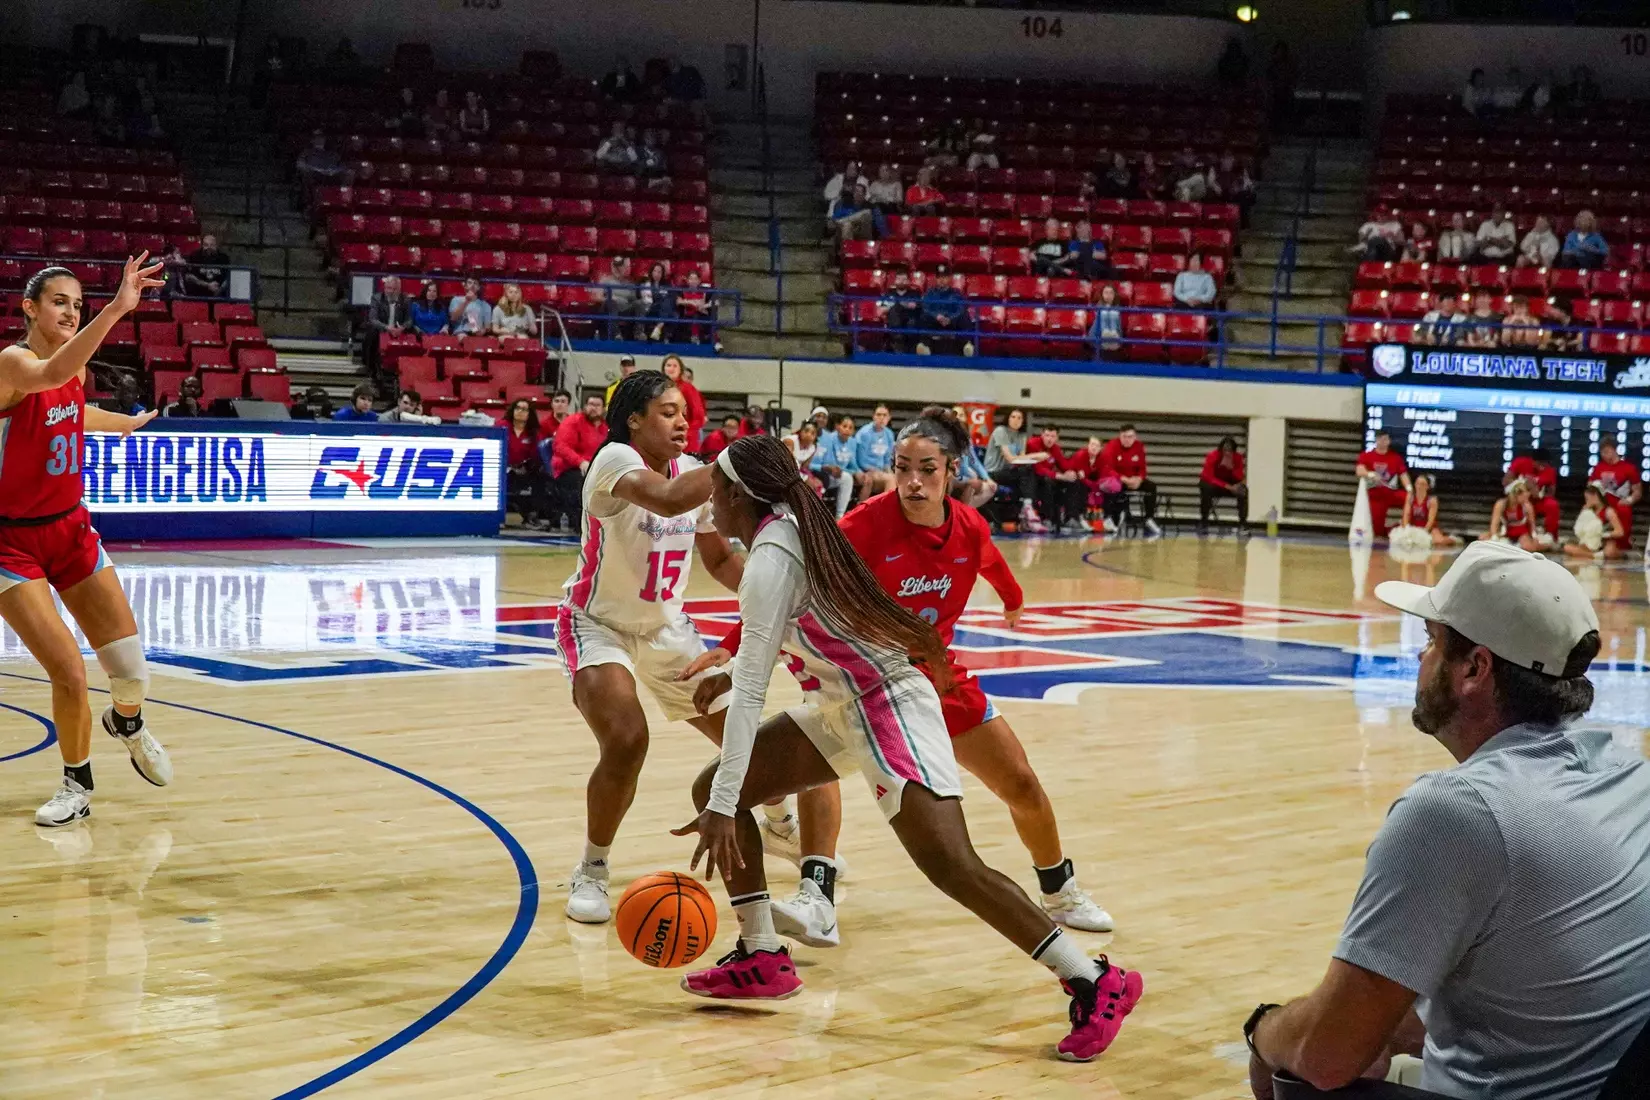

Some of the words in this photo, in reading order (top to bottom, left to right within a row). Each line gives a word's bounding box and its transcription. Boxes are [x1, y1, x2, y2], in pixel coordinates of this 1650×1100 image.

[1020, 16, 1066, 38] 104
[1412, 351, 1540, 379] LOUISIANA
[1541, 358, 1607, 382] TECH
[45, 400, 79, 426] Liberty
[45, 432, 79, 476] 31
[639, 550, 688, 602] 15
[897, 574, 952, 599] Liberty
